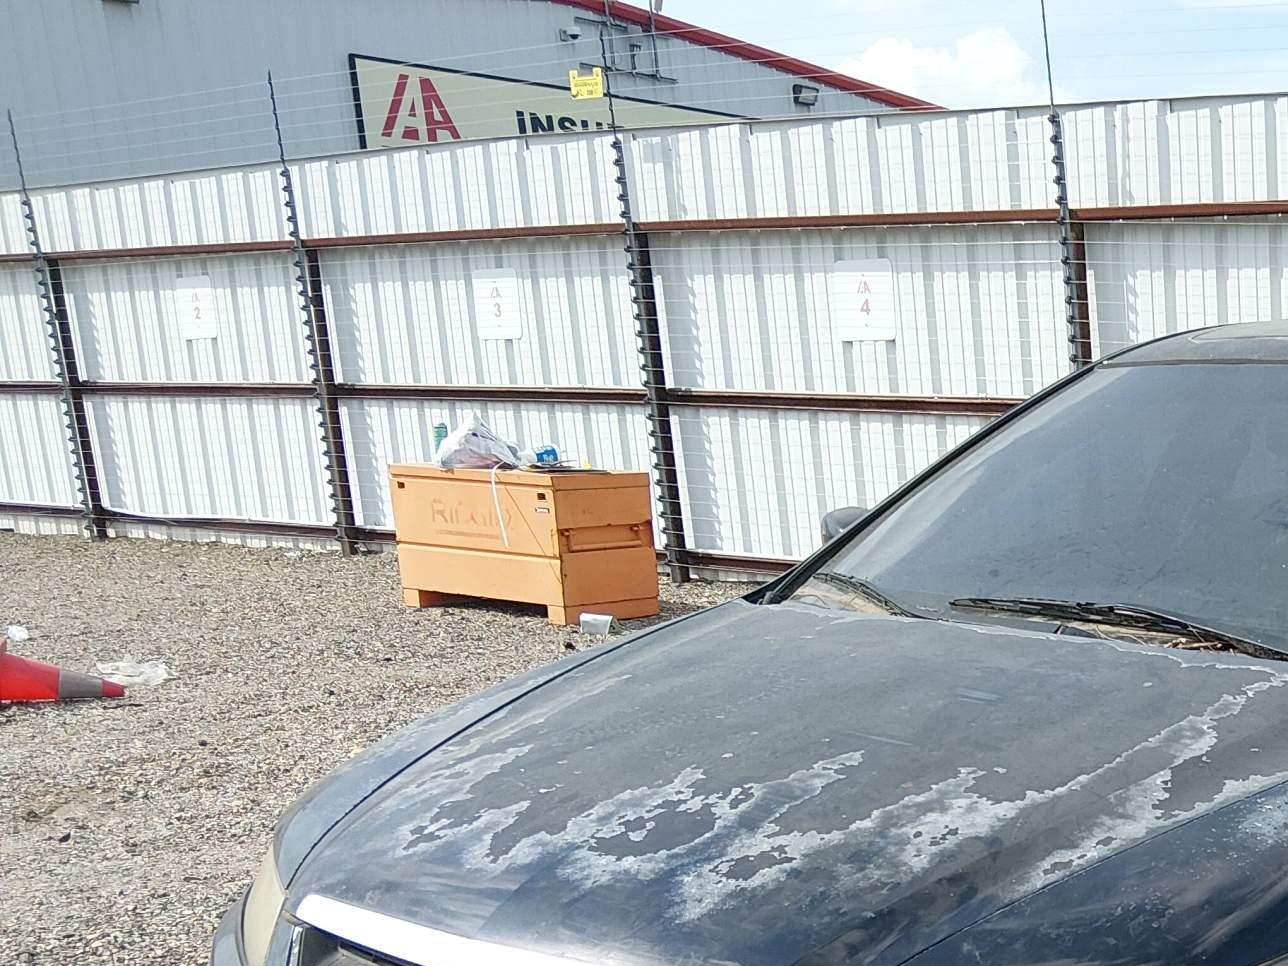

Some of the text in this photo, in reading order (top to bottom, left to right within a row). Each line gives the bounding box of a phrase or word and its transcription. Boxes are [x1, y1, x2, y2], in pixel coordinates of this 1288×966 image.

[194, 306, 202, 320] 2
[494, 302, 502, 318] 3
[860, 298, 871, 316] 4
